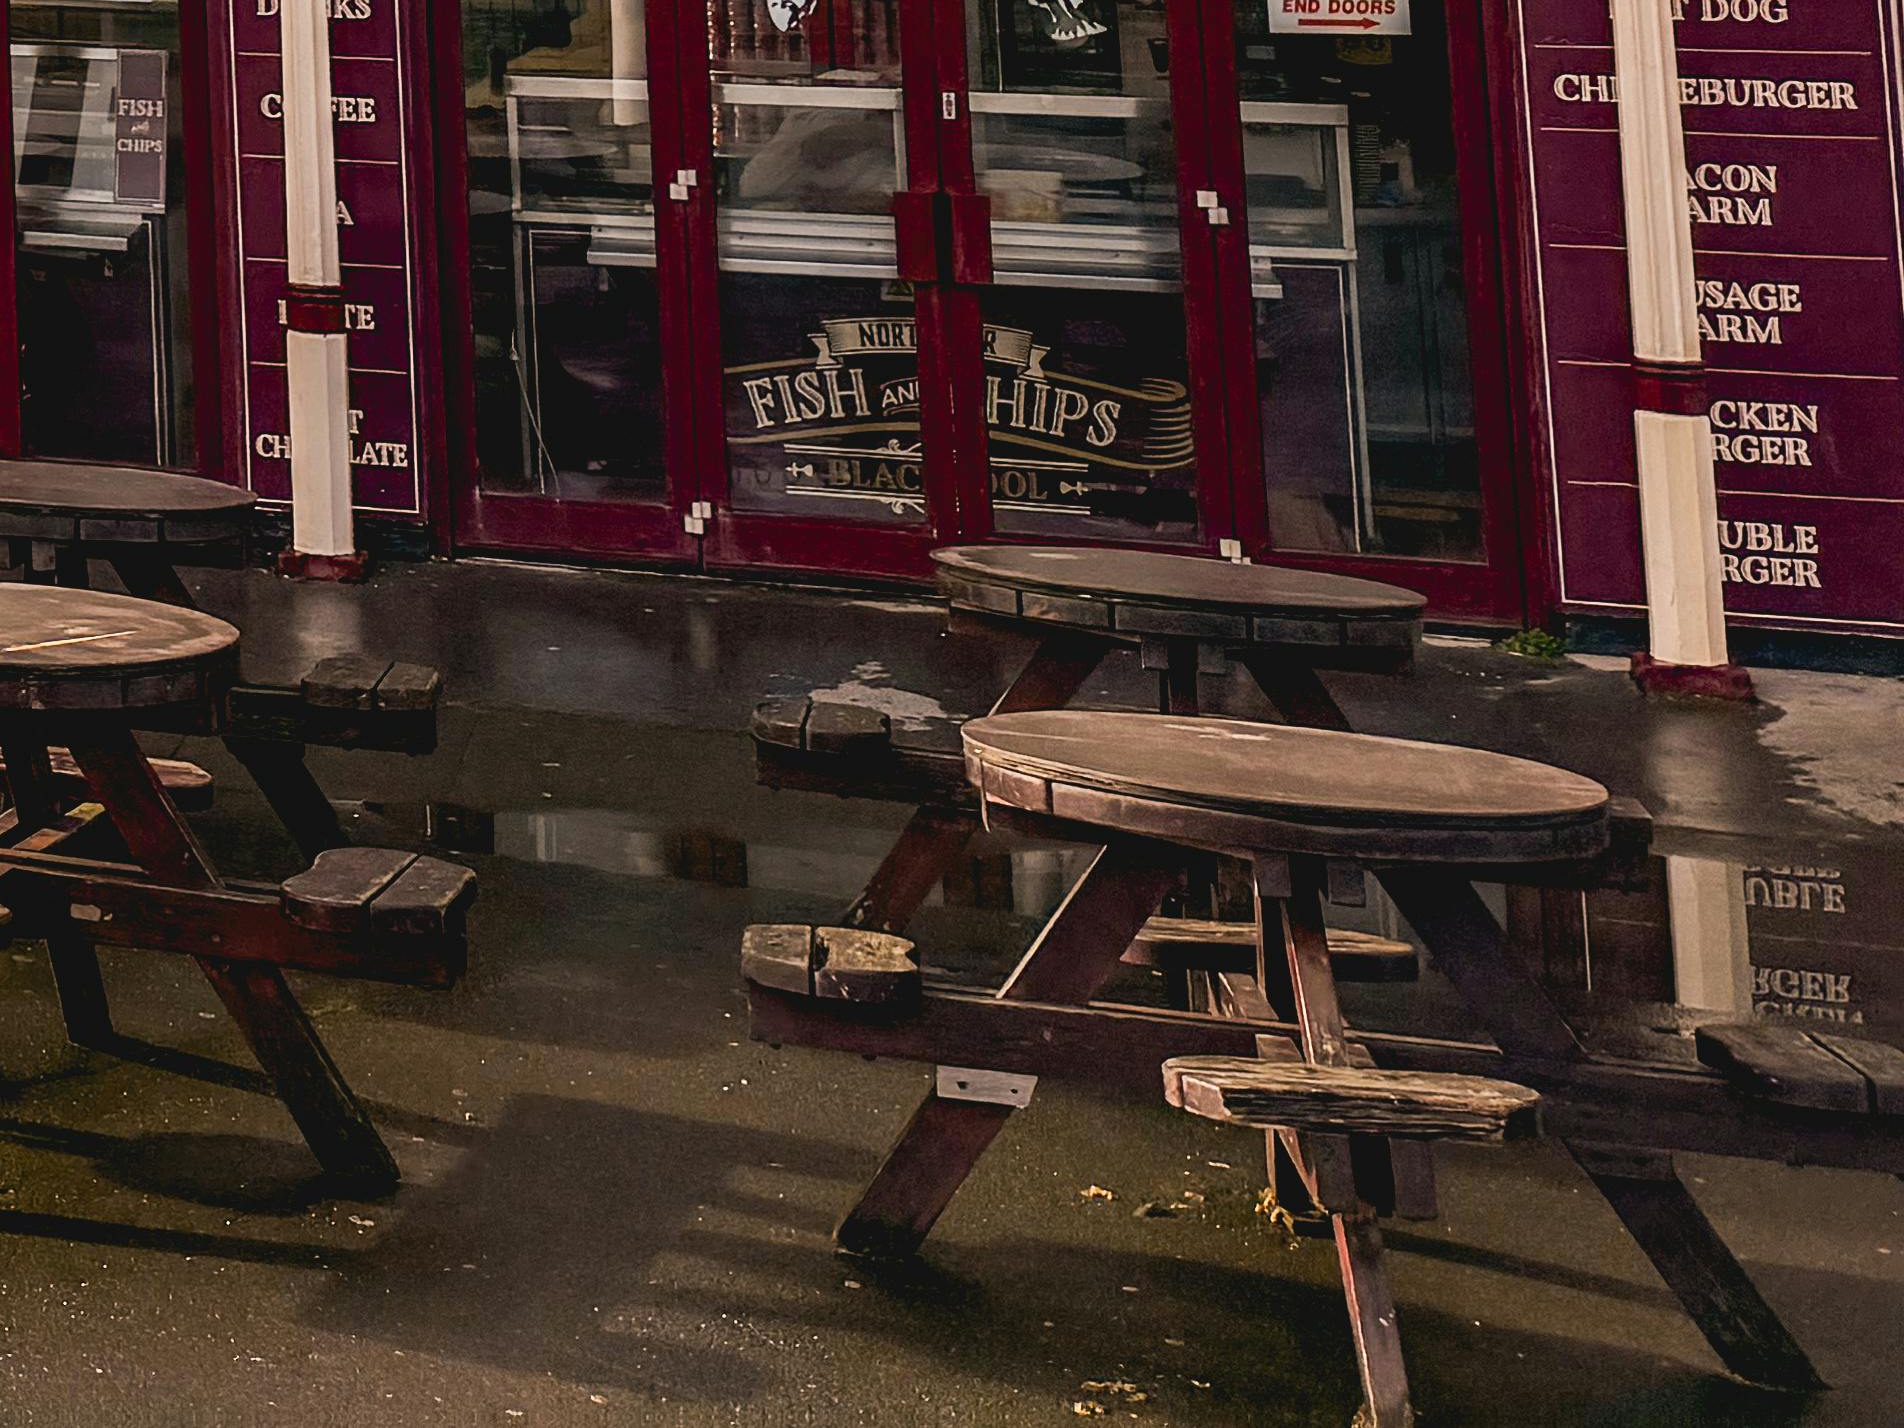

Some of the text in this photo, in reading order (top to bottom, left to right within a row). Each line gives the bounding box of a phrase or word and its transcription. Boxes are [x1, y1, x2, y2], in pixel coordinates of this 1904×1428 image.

[118, 99, 163, 117] FISH
[117, 138, 162, 153] CHIPS
[1687, 196, 1773, 227] ARM
[858, 322, 917, 351] NORT
[1698, 313, 1783, 345] ARM
[742, 368, 1121, 447] FISH AN HIPS
[1709, 399, 1819, 434] CKEN
[255, 434, 408, 468] CHLATE
[1711, 432, 1813, 467] RGER
[1718, 519, 1819, 554] UBLE
[1720, 553, 1822, 589] RGER
